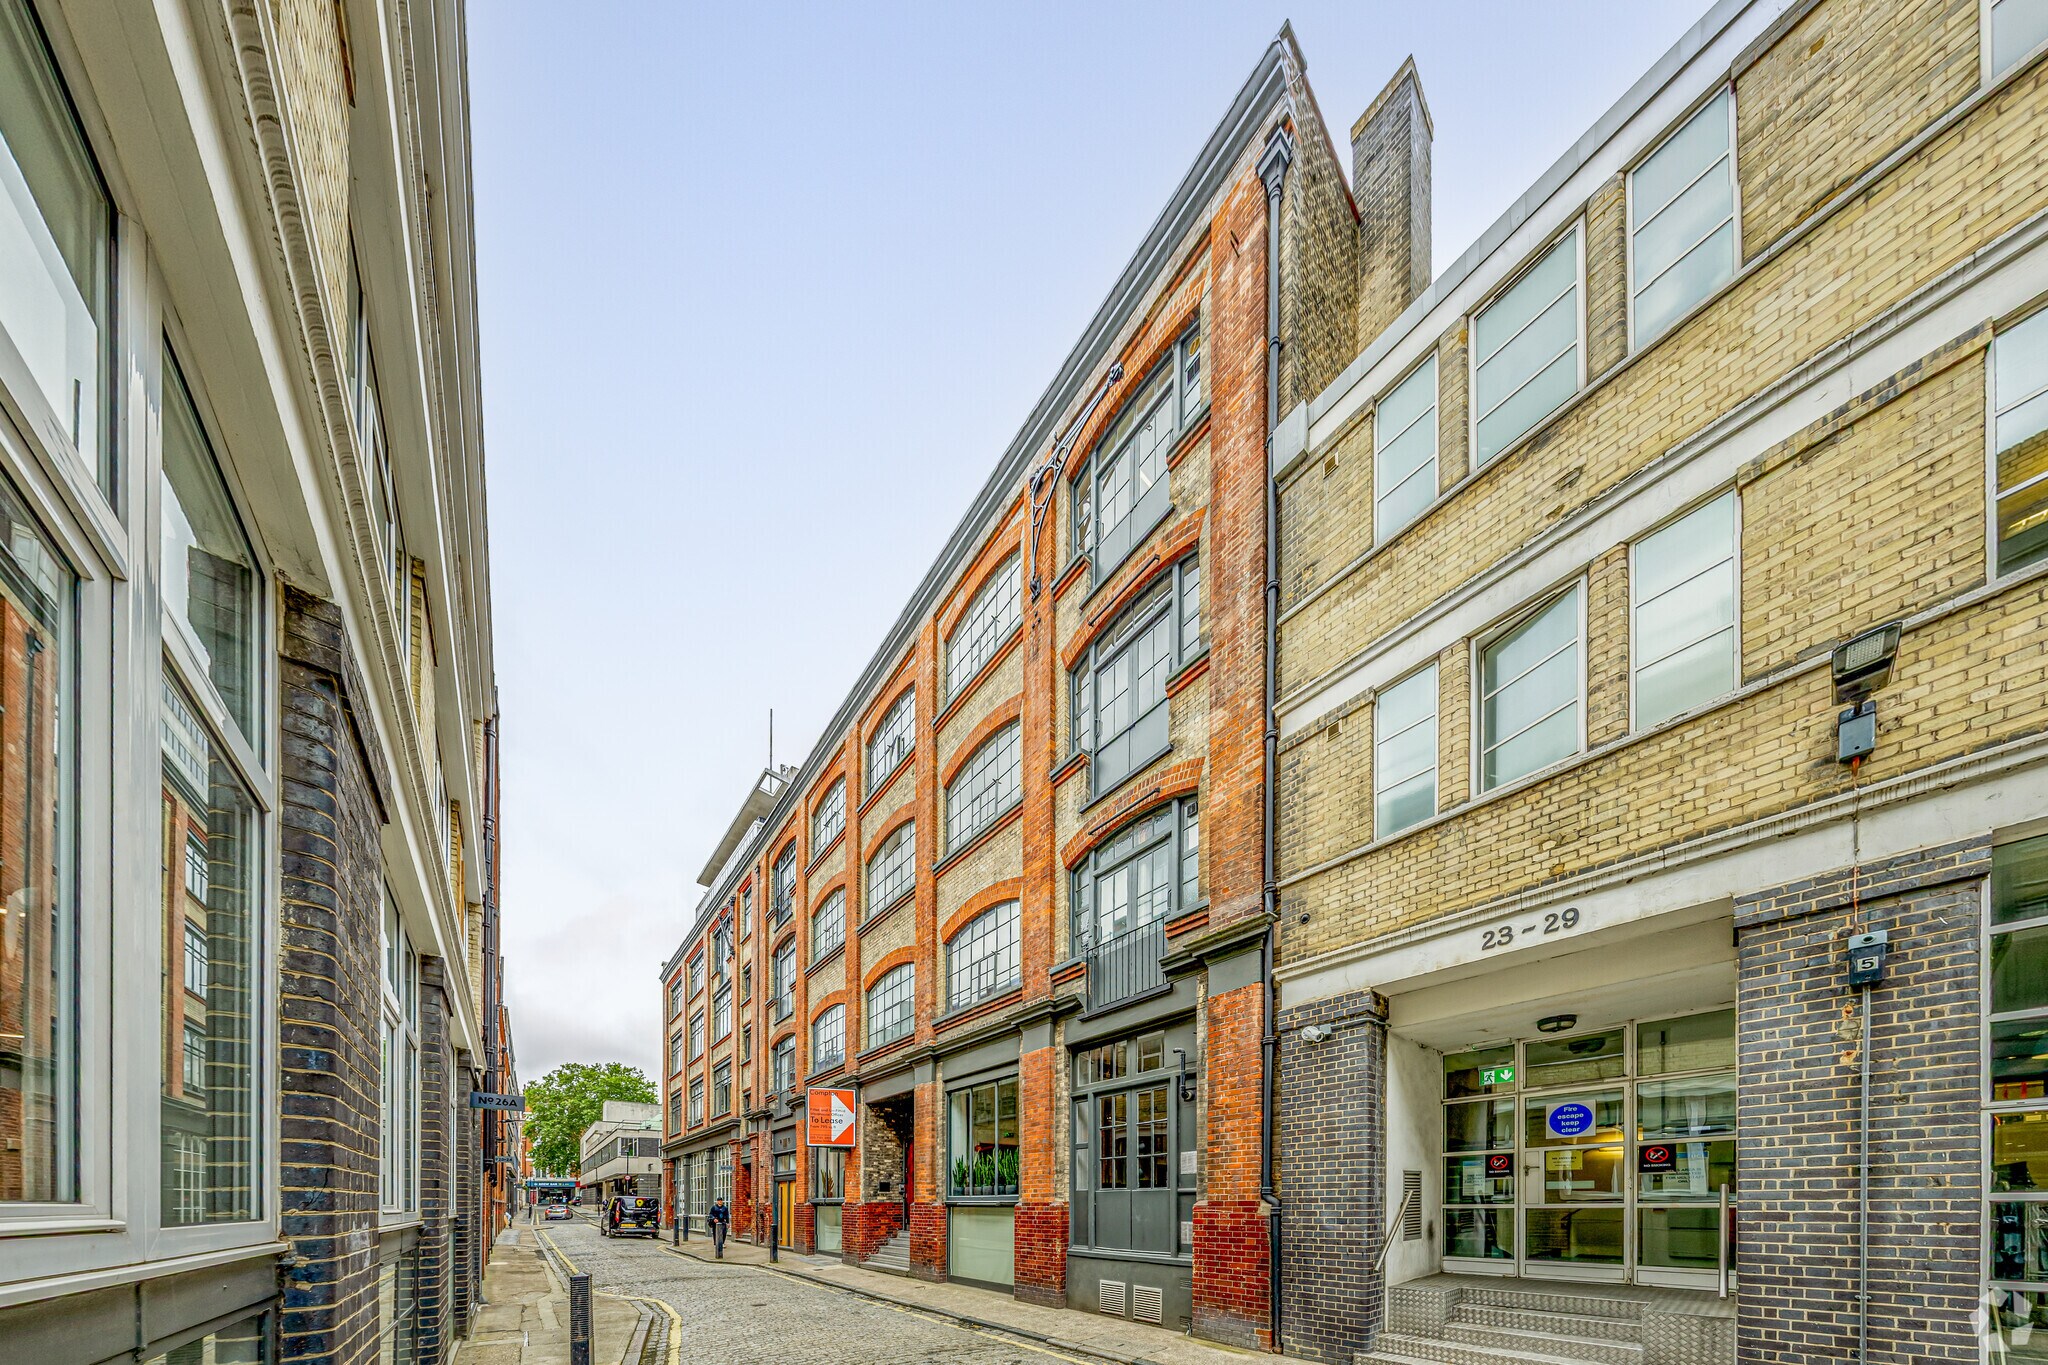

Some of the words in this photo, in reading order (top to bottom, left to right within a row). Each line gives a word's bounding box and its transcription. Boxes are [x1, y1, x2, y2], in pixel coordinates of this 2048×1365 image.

[1481, 925, 1514, 951] 23
[1543, 907, 1580, 935] 29
[1861, 958, 1875, 969] 5
[809, 1089, 839, 1097] Compton
[820, 1116, 844, 1124] Lease
